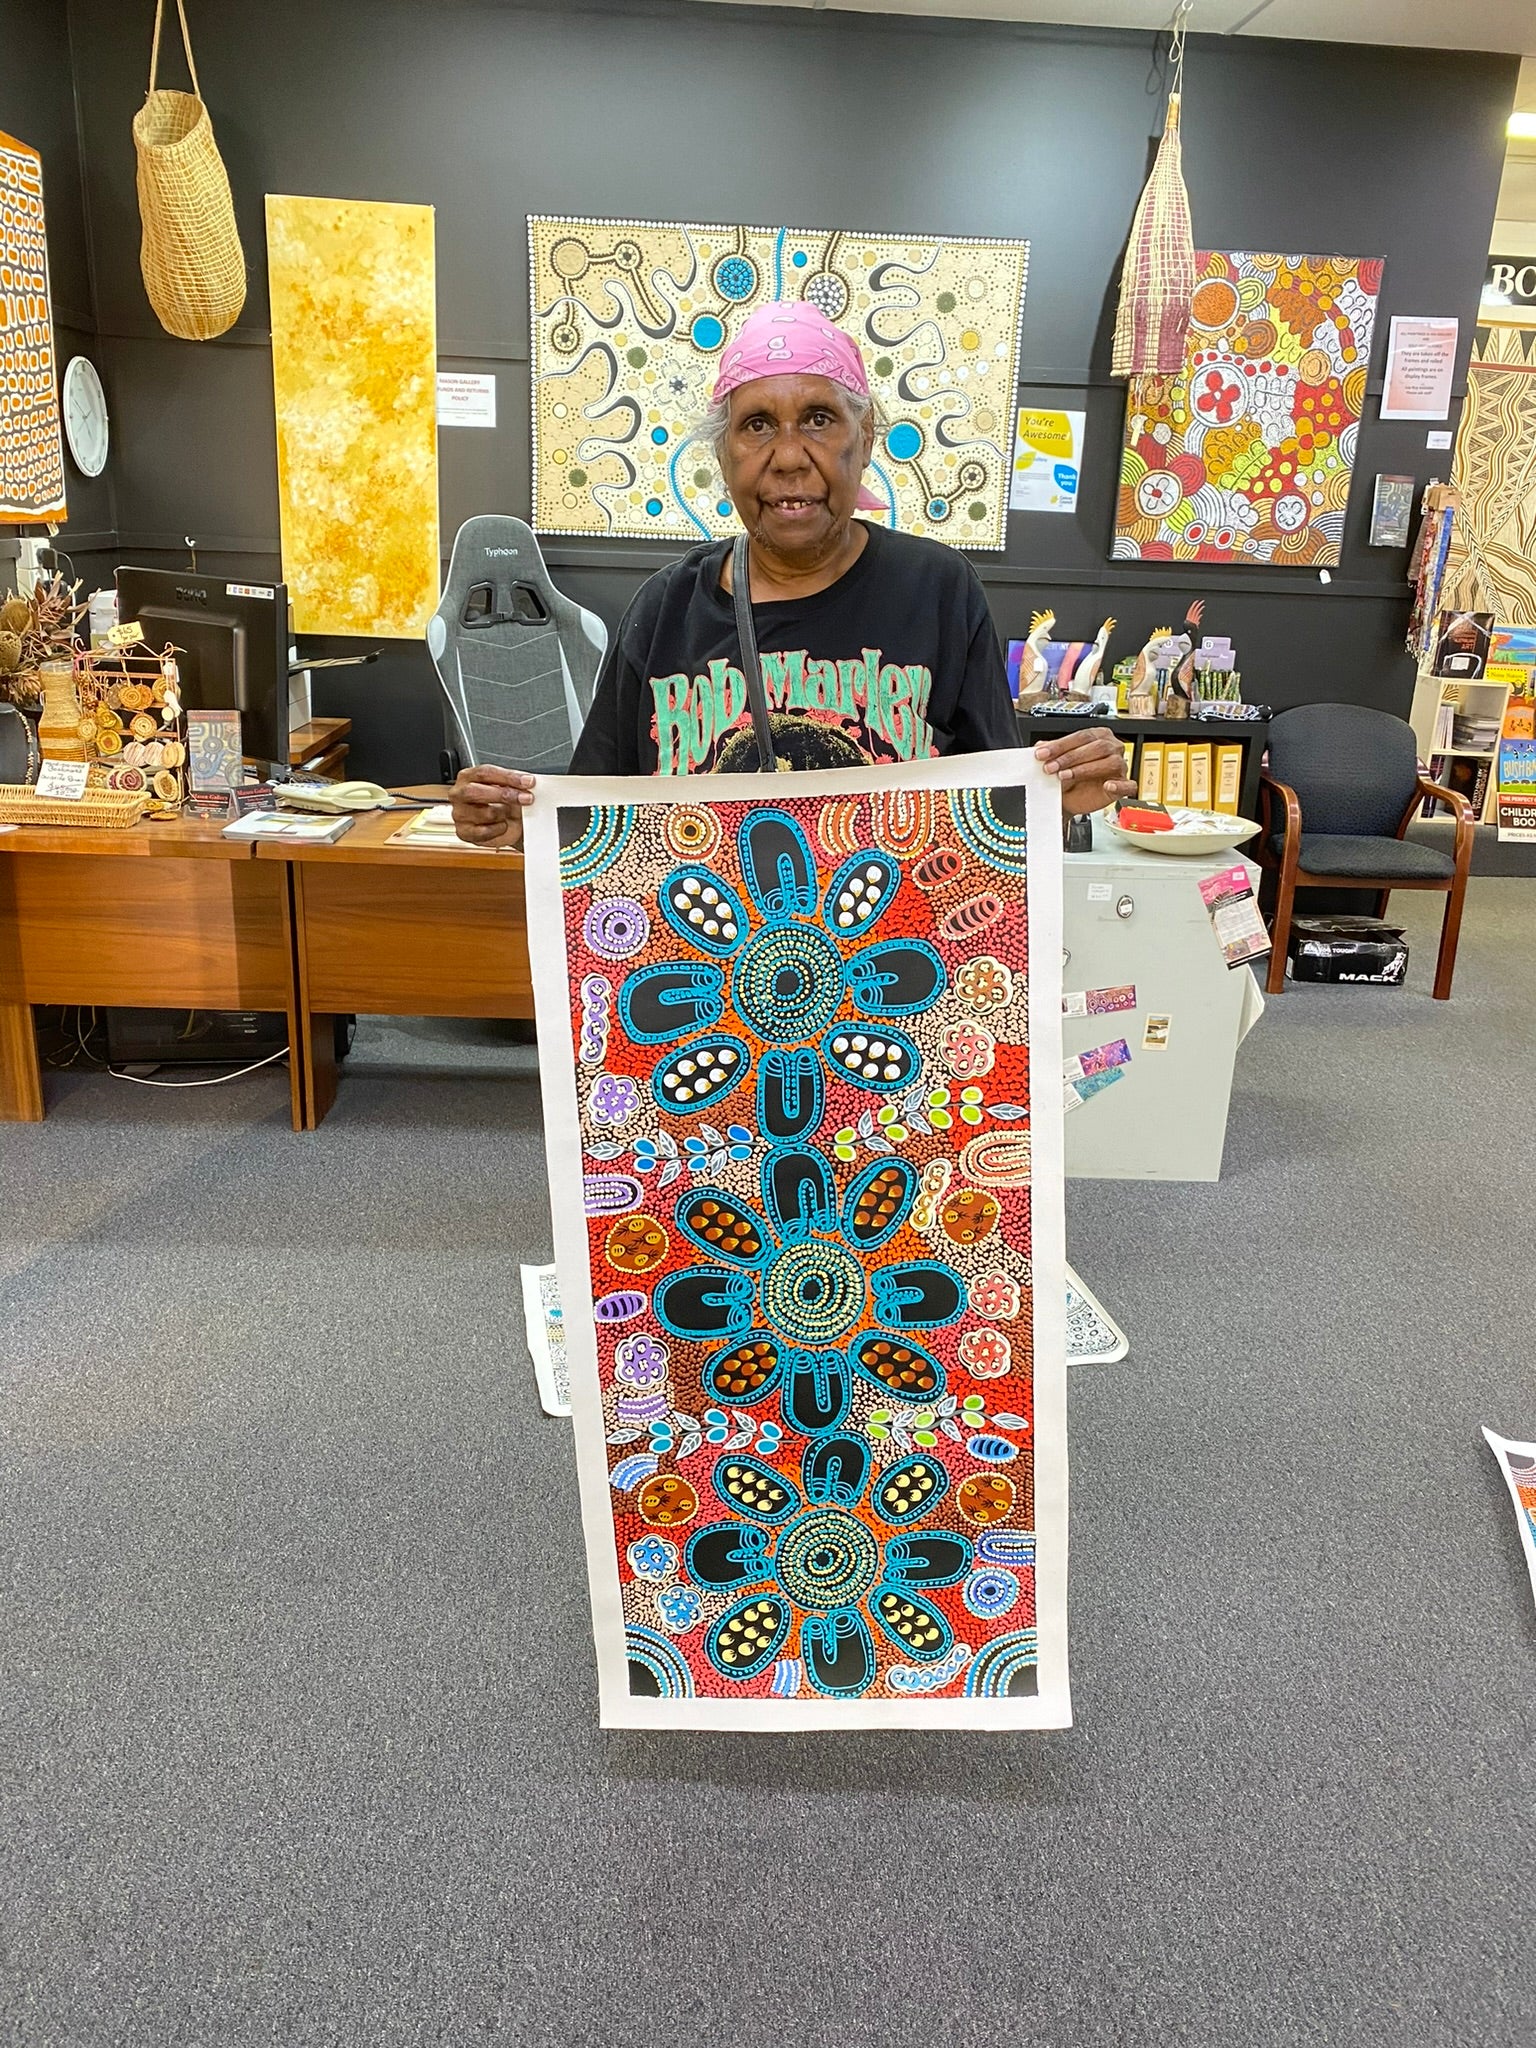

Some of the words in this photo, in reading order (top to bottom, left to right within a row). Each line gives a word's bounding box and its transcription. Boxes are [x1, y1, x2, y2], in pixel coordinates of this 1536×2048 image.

[1491, 264, 1536, 297] BO
[1025, 417, 1054, 427] You're
[484, 547, 518, 557] Typhoon
[649, 657, 747, 776] Bob
[758, 647, 933, 761] Marley
[1503, 760, 1525, 778] BUSH
[1501, 807, 1536, 817] CHILDR
[1513, 817, 1536, 827] BOO
[1339, 973, 1397, 982] MACK
